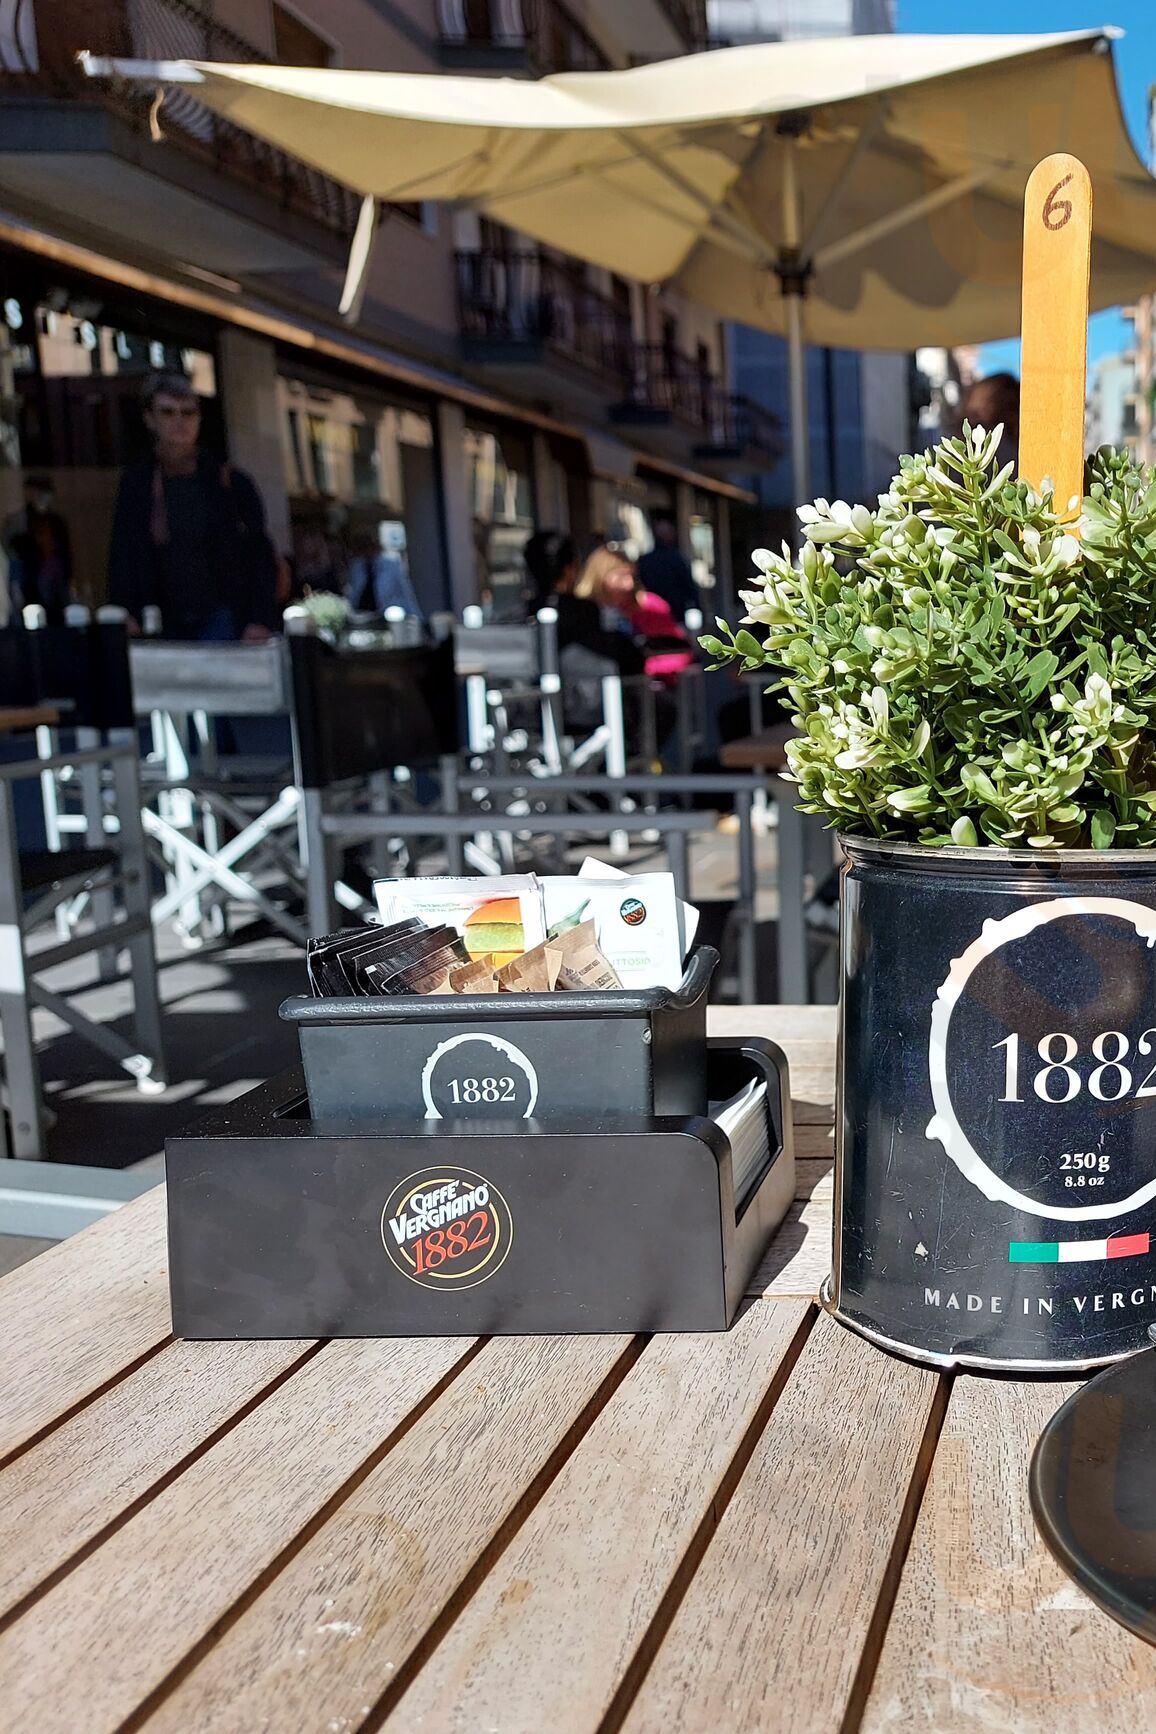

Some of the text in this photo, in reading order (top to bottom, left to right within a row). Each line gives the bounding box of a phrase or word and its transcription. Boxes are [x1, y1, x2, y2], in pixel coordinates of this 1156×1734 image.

[1042, 172, 1073, 231] 6
[446, 1076, 516, 1104] 1882
[1064, 1175, 1105, 1188] 8.8 oz
[388, 1183, 490, 1245] VERGNANO
[411, 1210, 492, 1276] 1882
[924, 1287, 1003, 1314] MADE
[1022, 1298, 1053, 1315] IN
